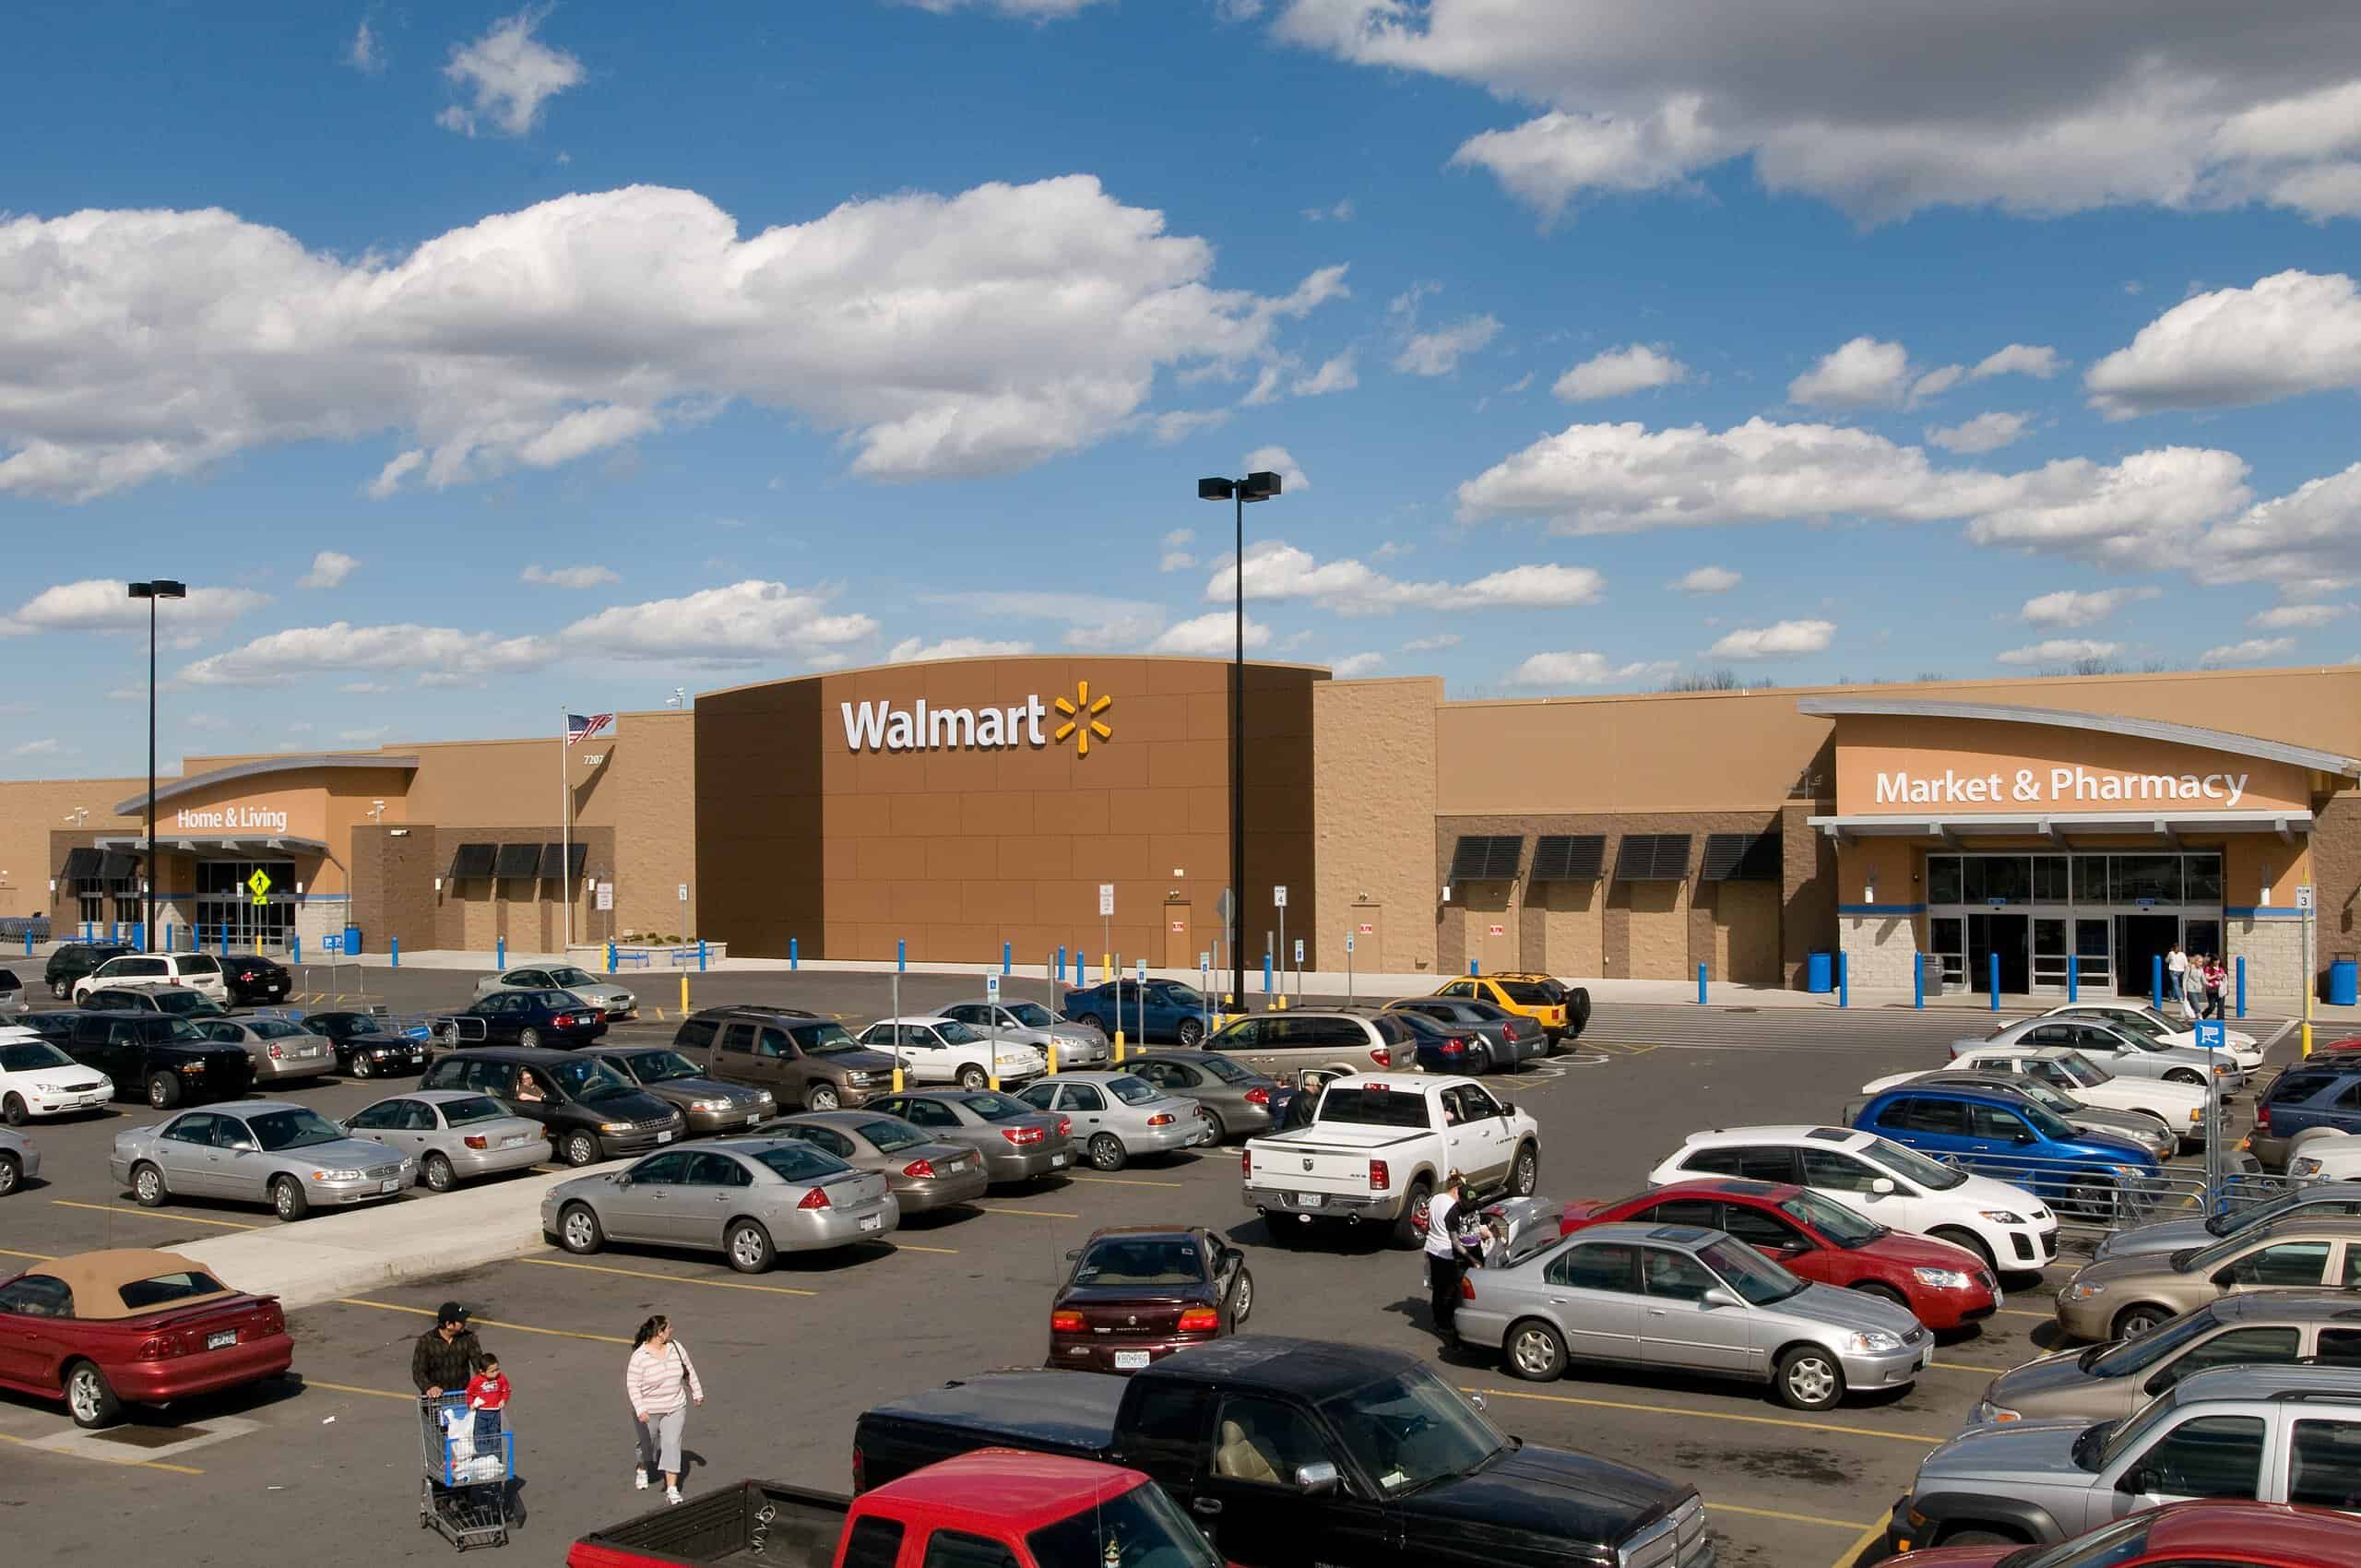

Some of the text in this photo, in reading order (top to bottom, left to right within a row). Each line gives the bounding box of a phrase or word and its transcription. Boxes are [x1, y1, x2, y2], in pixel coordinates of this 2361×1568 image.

[841, 694, 1047, 750] Walmart
[583, 754, 605, 765] 7207
[1875, 767, 2248, 807] Market & Pharmacy
[178, 806, 287, 833] Home & Living
[2301, 897, 2308, 906] 3
